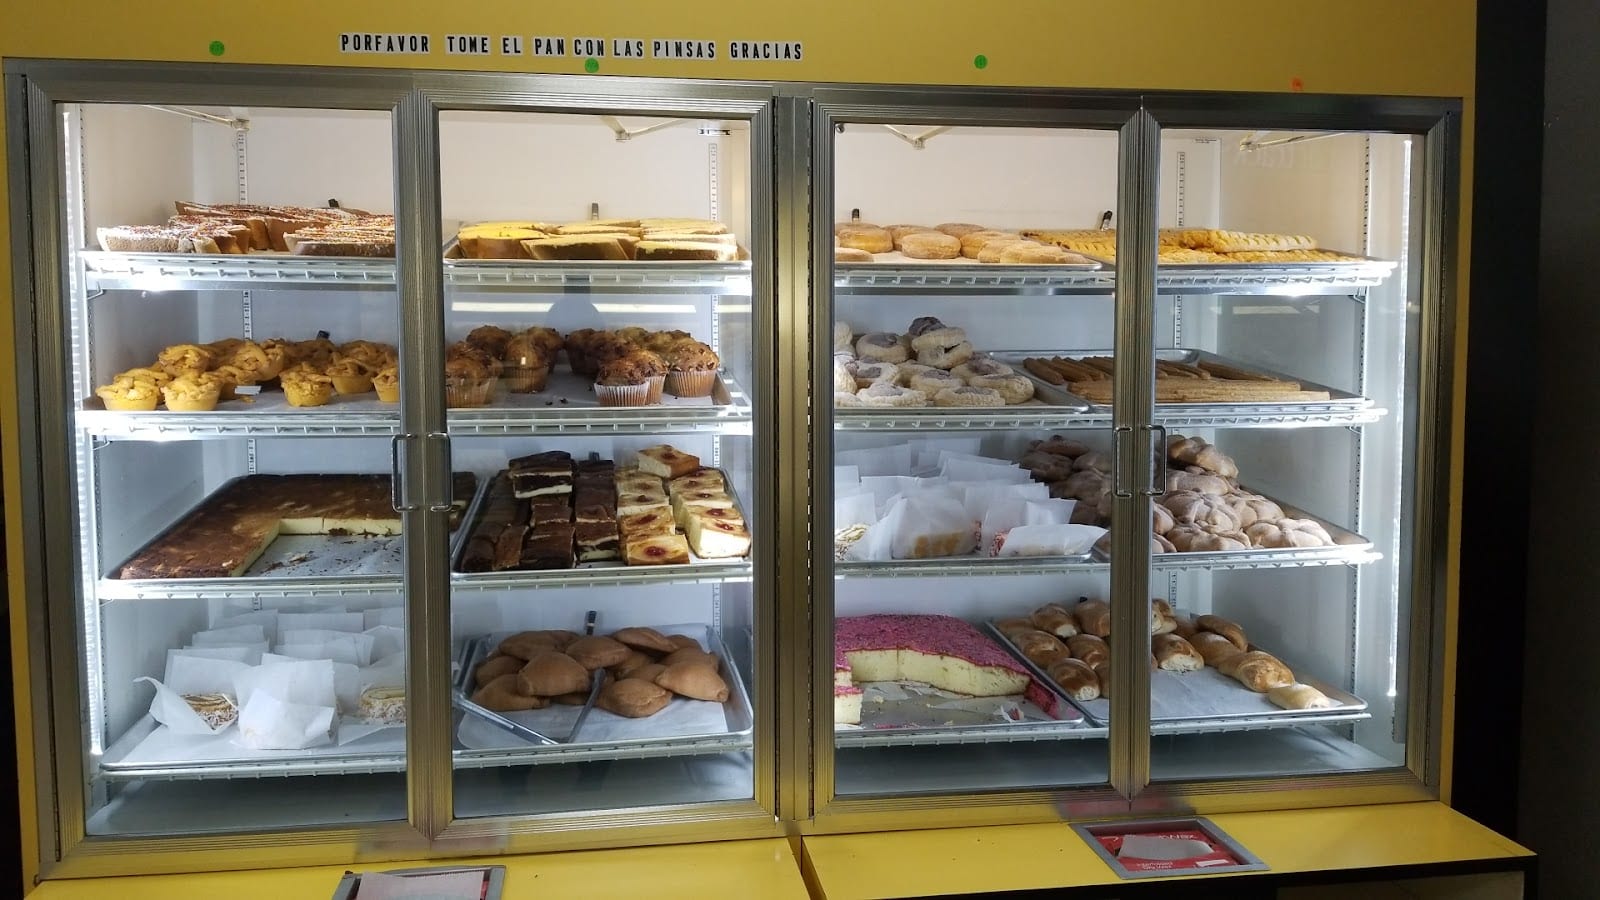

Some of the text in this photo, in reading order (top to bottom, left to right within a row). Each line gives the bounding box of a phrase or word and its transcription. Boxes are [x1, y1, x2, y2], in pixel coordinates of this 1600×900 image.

[341, 34, 802, 60] PORFAVOR TOME EL PAN CON LAS PINSAS GRACIAS
